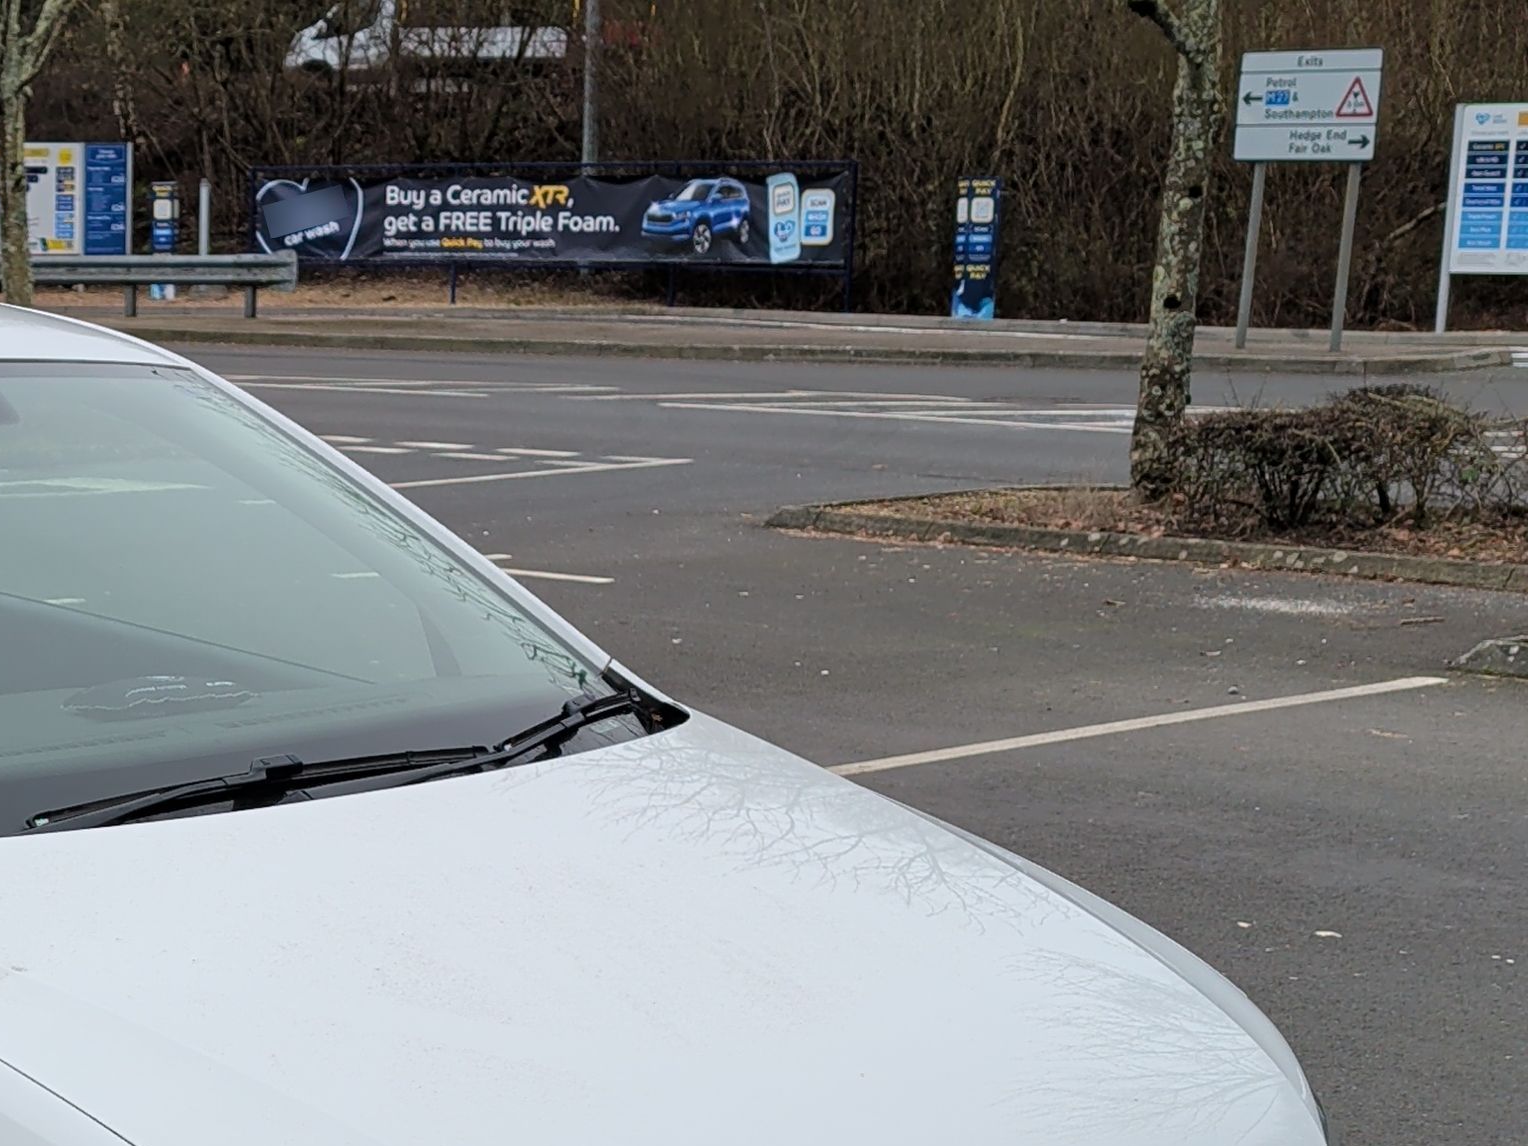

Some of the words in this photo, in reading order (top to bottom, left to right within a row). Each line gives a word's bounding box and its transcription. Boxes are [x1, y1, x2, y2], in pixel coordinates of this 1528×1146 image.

[1297, 56, 1323, 67] Exits
[1266, 77, 1296, 87] Petrol
[1265, 109, 1333, 120] Southampton
[1289, 130, 1322, 141] Hedge
[1326, 130, 1347, 140] End
[1288, 143, 1307, 153] Fair
[1312, 143, 1332, 153] Oak
[386, 185, 425, 209] Buy
[429, 189, 442, 205] a
[447, 184, 529, 206] Ceramic
[384, 213, 417, 236] get
[422, 216, 434, 232] a
[439, 212, 492, 232] FREE
[496, 211, 553, 236] Triple
[558, 212, 620, 232] Foam.
[284, 231, 303, 246] car
[304, 221, 340, 240] wash
[383, 238, 407, 247] When
[441, 237, 465, 247] Quick
[466, 238, 483, 249] Pay
[494, 238, 511, 249] buy
[512, 239, 531, 249] your
